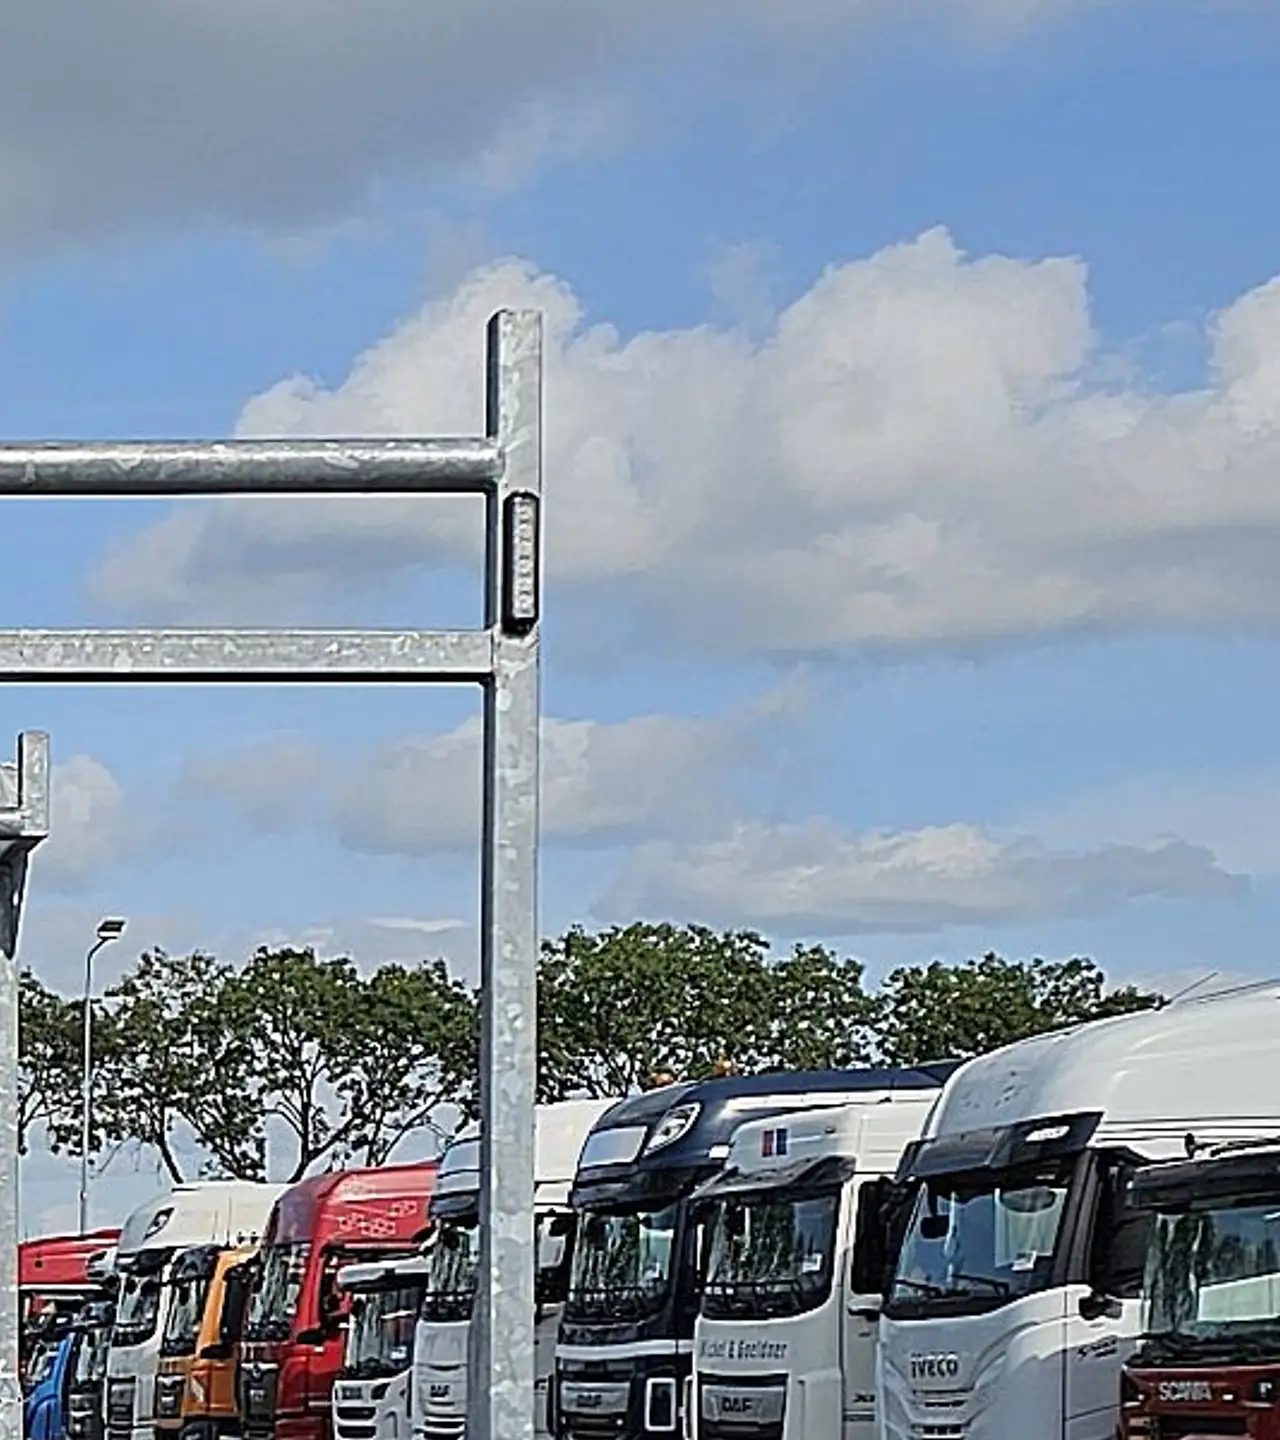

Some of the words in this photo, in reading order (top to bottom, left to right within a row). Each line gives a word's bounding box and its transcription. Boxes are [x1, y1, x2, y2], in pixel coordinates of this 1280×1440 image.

[910, 1352, 959, 1378] IVECO
[1158, 1381, 1213, 1401] SCANIA
[721, 1397, 753, 1413] DAF
